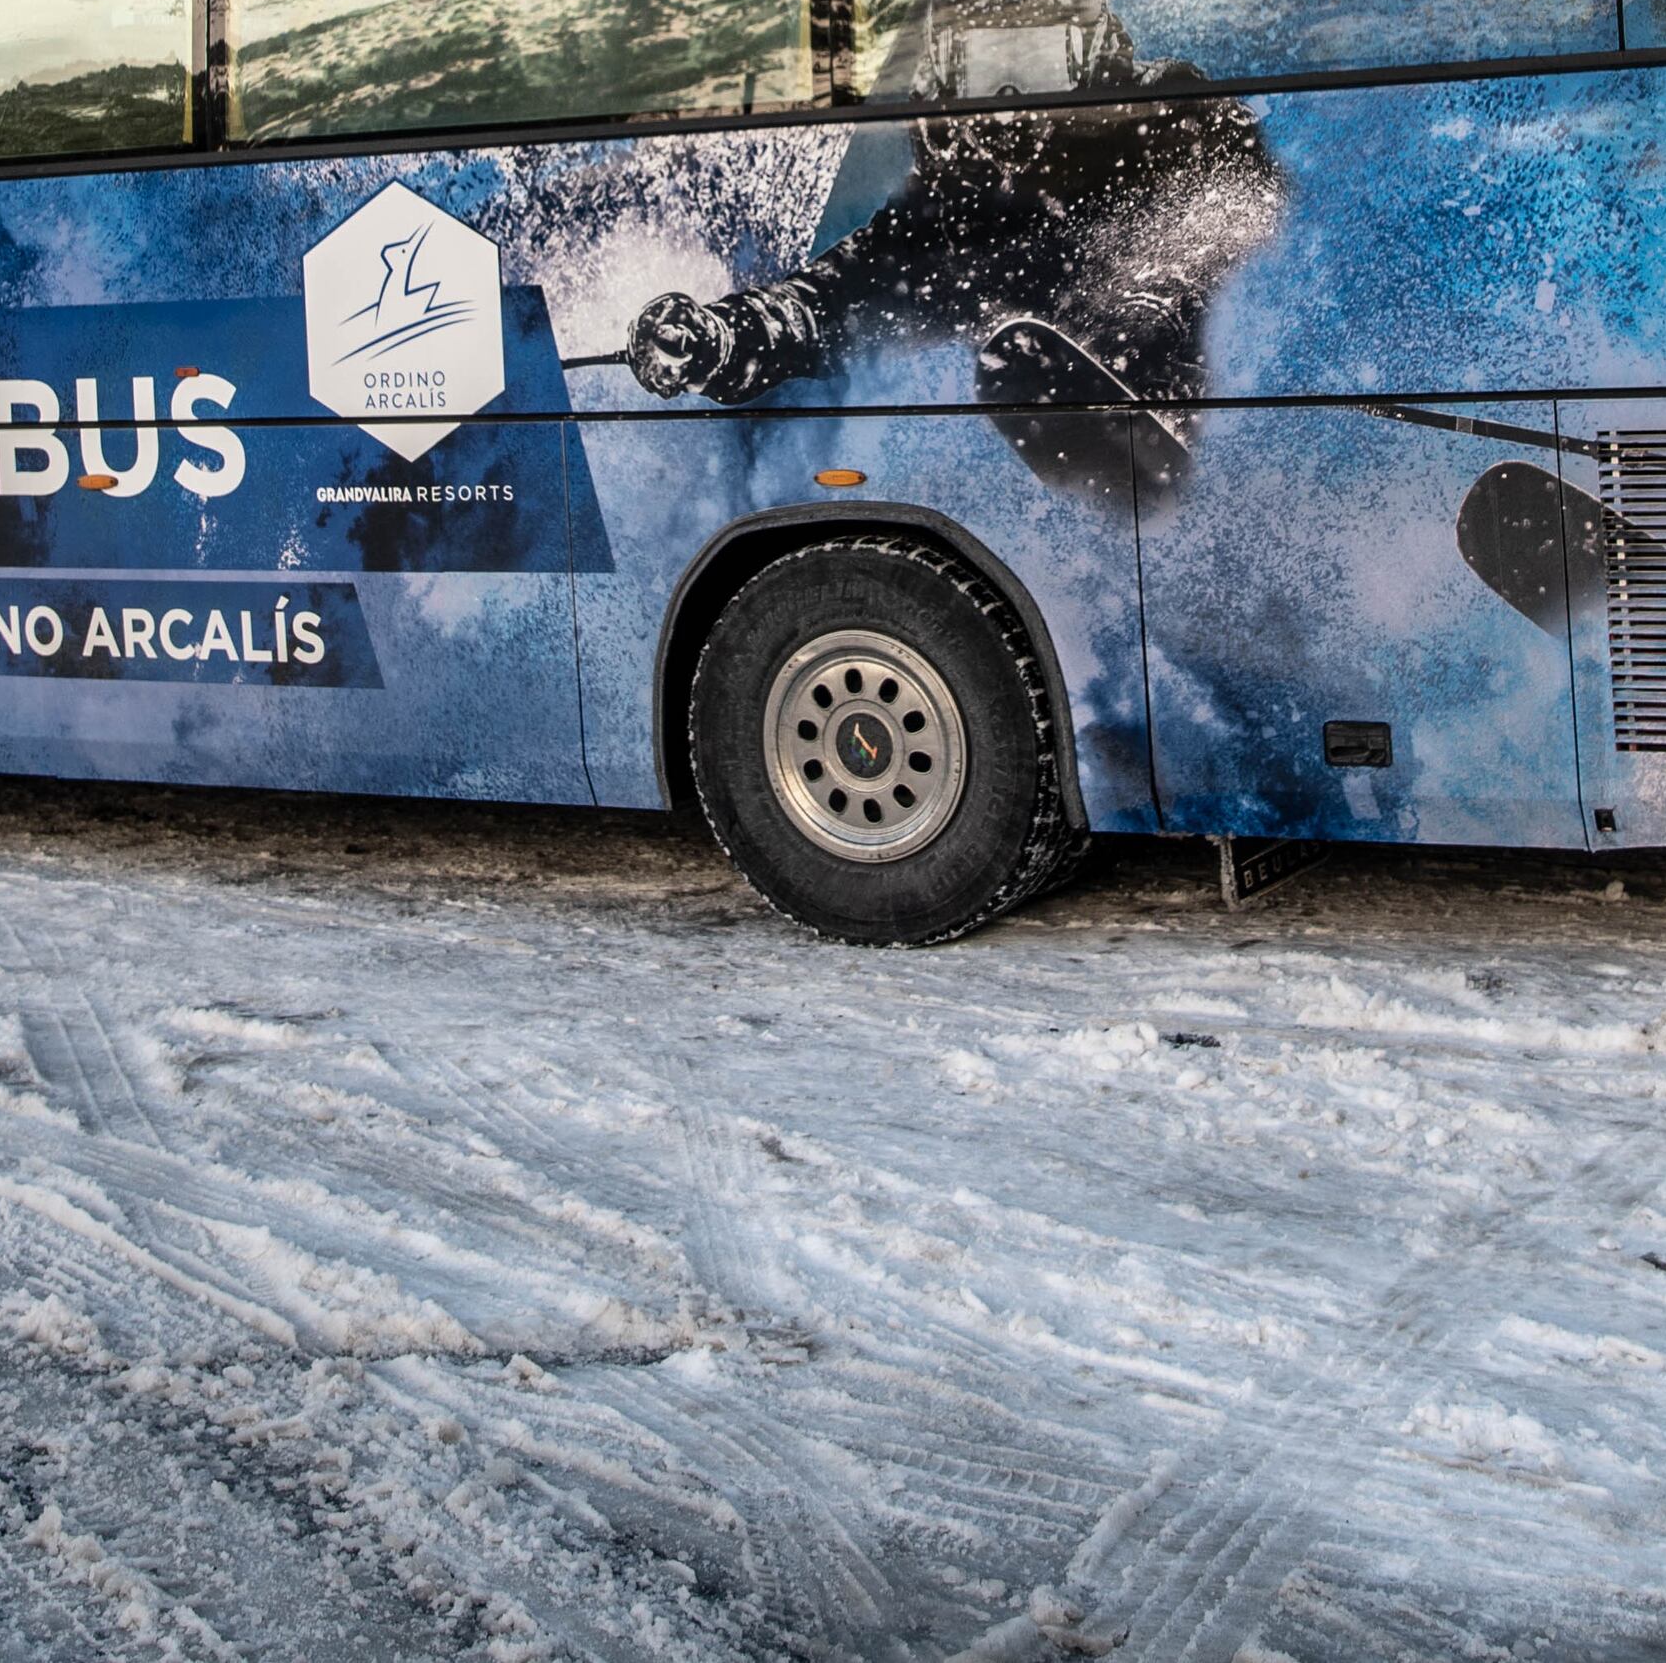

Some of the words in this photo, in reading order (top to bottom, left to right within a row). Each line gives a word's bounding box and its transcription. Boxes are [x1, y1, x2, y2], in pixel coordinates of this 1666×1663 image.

[363, 370, 446, 389] ORDINO
[365, 388, 447, 409] ARCALÍS
[316, 486, 413, 503] GRANDVALIRA
[416, 484, 515, 503] RESORTS
[80, 596, 327, 665] ARCALÍS
